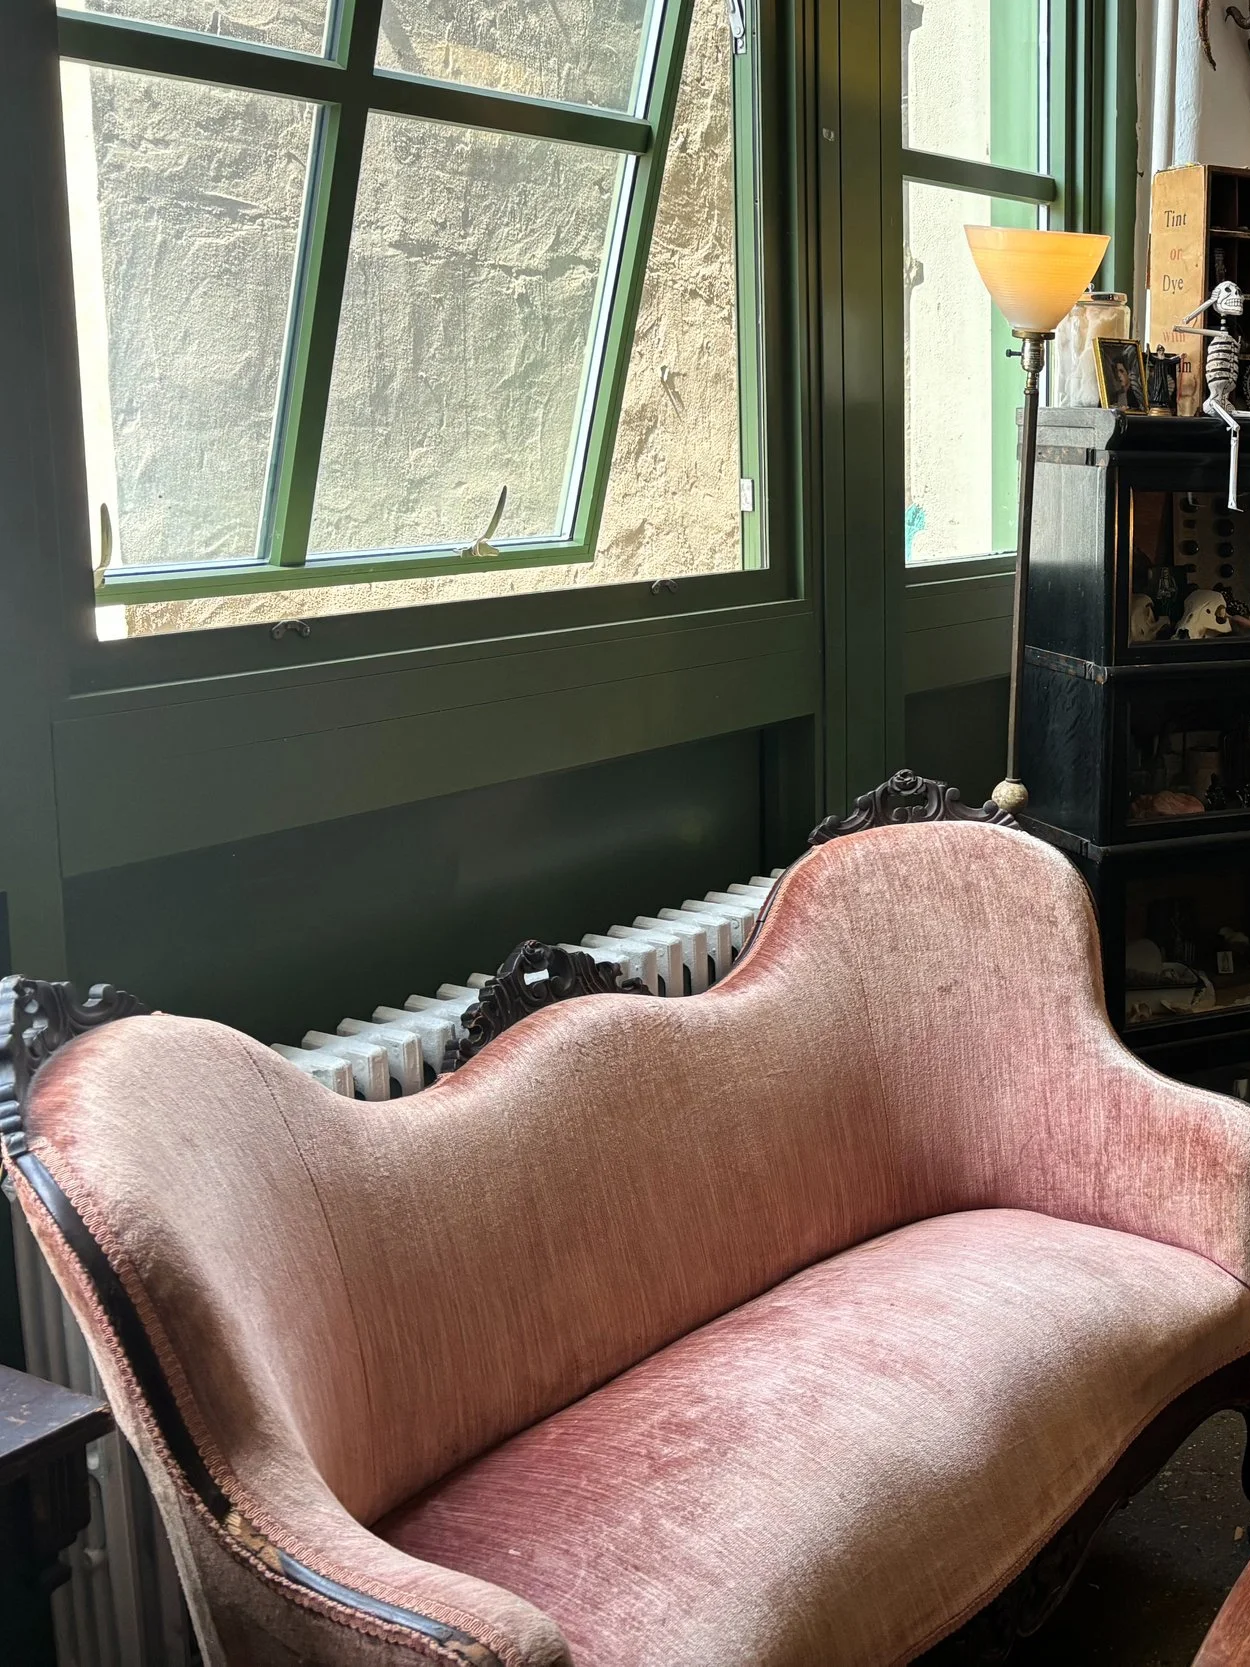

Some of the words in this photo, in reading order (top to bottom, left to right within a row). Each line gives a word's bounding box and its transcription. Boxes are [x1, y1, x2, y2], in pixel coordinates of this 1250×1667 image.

[1164, 209, 1188, 228] Tint
[1169, 247, 1183, 261] or
[1162, 274, 1184, 295] Dye
